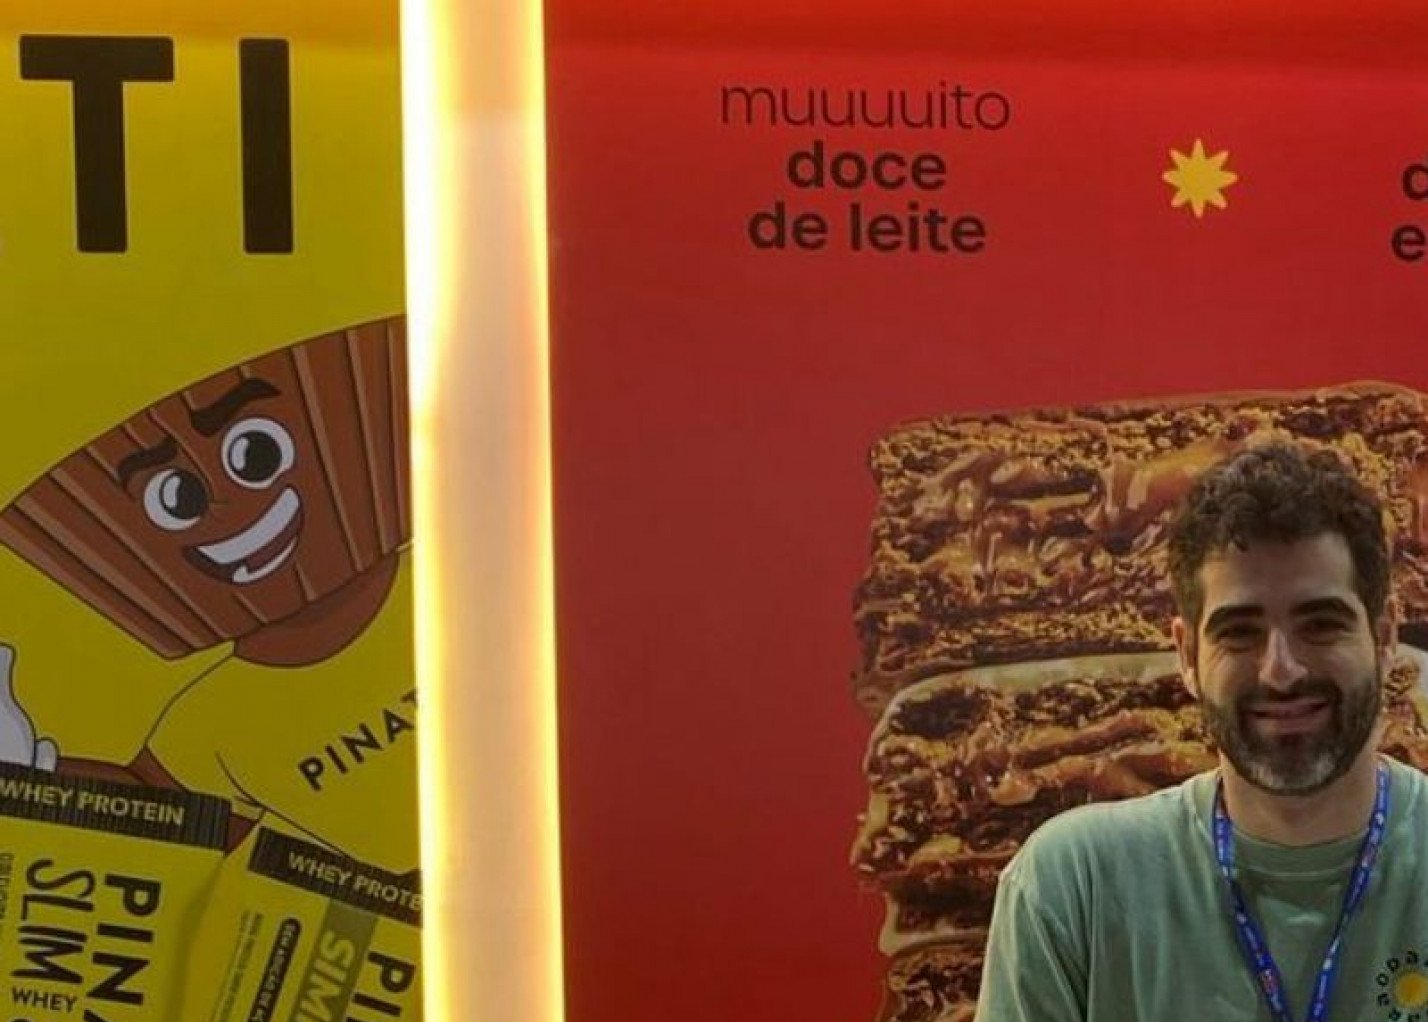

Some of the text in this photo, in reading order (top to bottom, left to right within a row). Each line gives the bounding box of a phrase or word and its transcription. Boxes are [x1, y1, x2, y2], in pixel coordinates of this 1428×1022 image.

[720, 81, 1011, 131] muuuuito
[20, 34, 294, 254] TI
[786, 139, 947, 190] doce
[748, 202, 986, 253] de leite
[0, 777, 185, 825] WHEY PROTEIN
[289, 851, 352, 887] WHEY
[11, 859, 95, 984] SLIM
[12, 986, 77, 1013] WHEY
